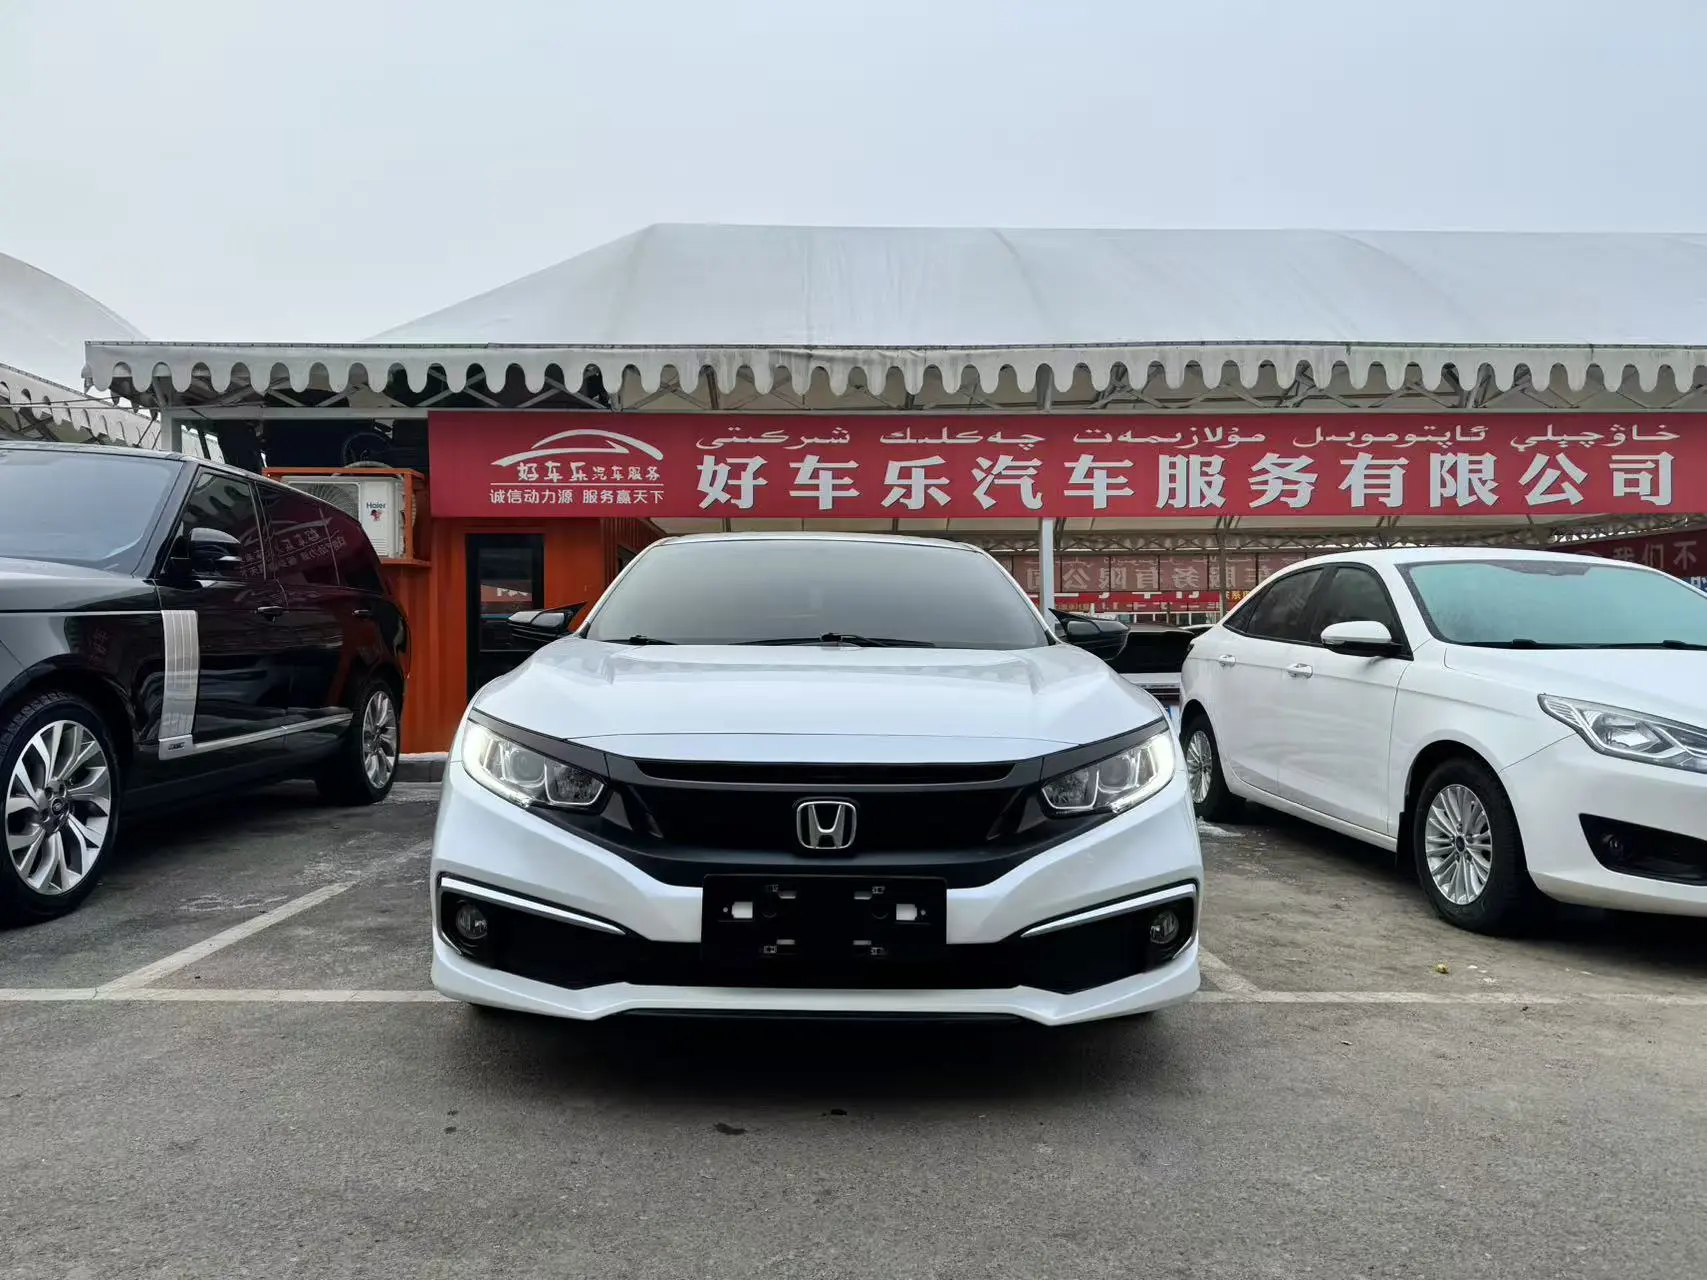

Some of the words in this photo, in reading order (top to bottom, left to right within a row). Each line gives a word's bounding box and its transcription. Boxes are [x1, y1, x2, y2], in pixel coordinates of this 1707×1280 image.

[490, 489, 573, 504] 诚信动力源
[583, 489, 664, 504] 服务赢天下
[697, 453, 1674, 511] 好车乐汽车服务有限公司
